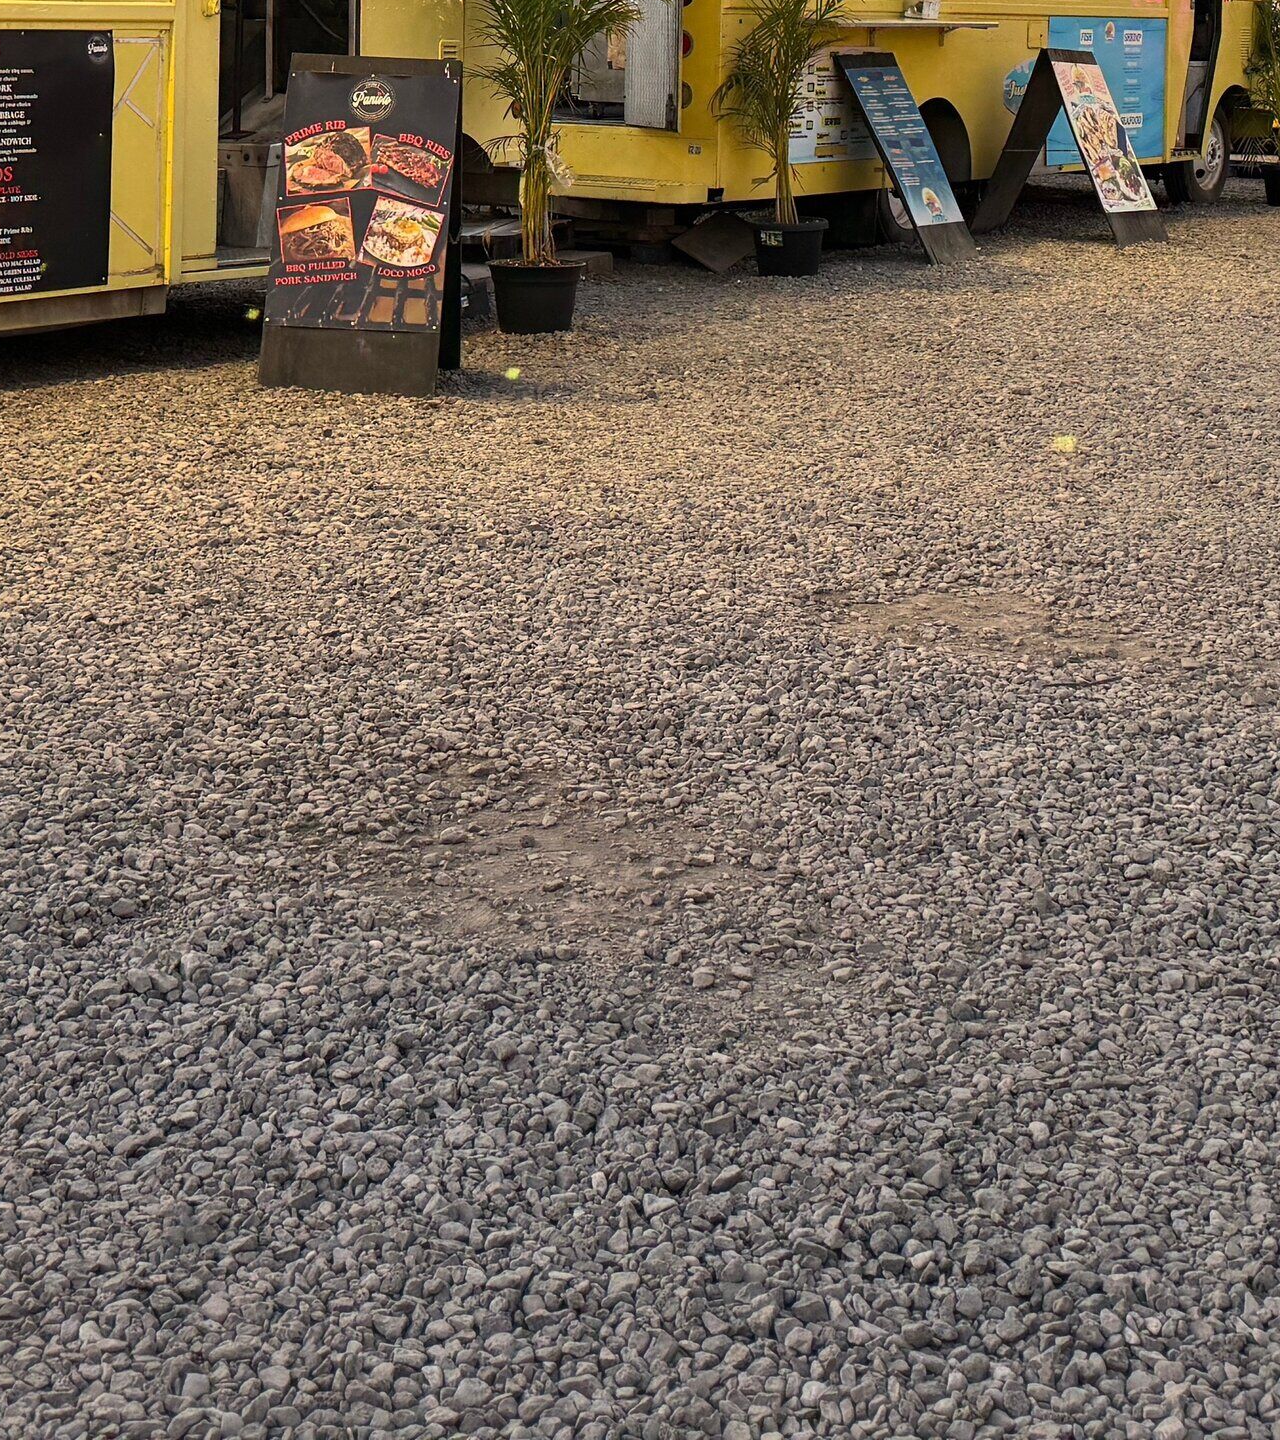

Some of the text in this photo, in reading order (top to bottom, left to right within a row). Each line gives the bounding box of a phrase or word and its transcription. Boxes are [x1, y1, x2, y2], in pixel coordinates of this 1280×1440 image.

[352, 90, 393, 107] Paniolo
[285, 120, 346, 146] PRIME RIB
[398, 133, 451, 159] BBQ RIBS
[286, 261, 346, 273] BBQ PULLED
[378, 264, 436, 278] LOCO MOCO
[275, 272, 357, 285] PORK SANDWICH
